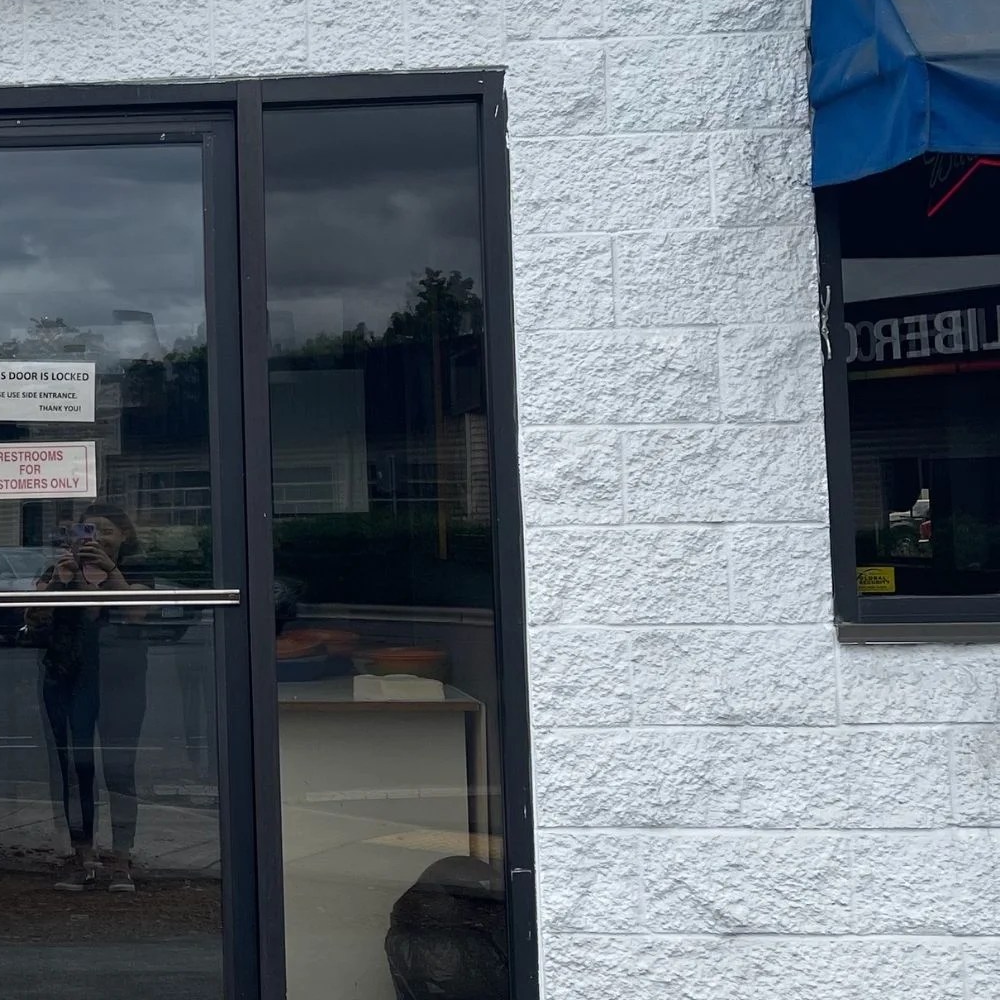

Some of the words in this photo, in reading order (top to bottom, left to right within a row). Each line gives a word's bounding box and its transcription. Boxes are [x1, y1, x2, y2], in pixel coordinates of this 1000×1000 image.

[8, 371, 38, 381] DOOR
[40, 371, 49, 381] IS
[51, 372, 89, 382] LOCKED
[7, 391, 20, 399] USE
[21, 391, 38, 399] SIDE
[39, 392, 78, 400] ENTRANCE.
[19, 464, 41, 475] FOR
[50, 478, 80, 489] ONLY
